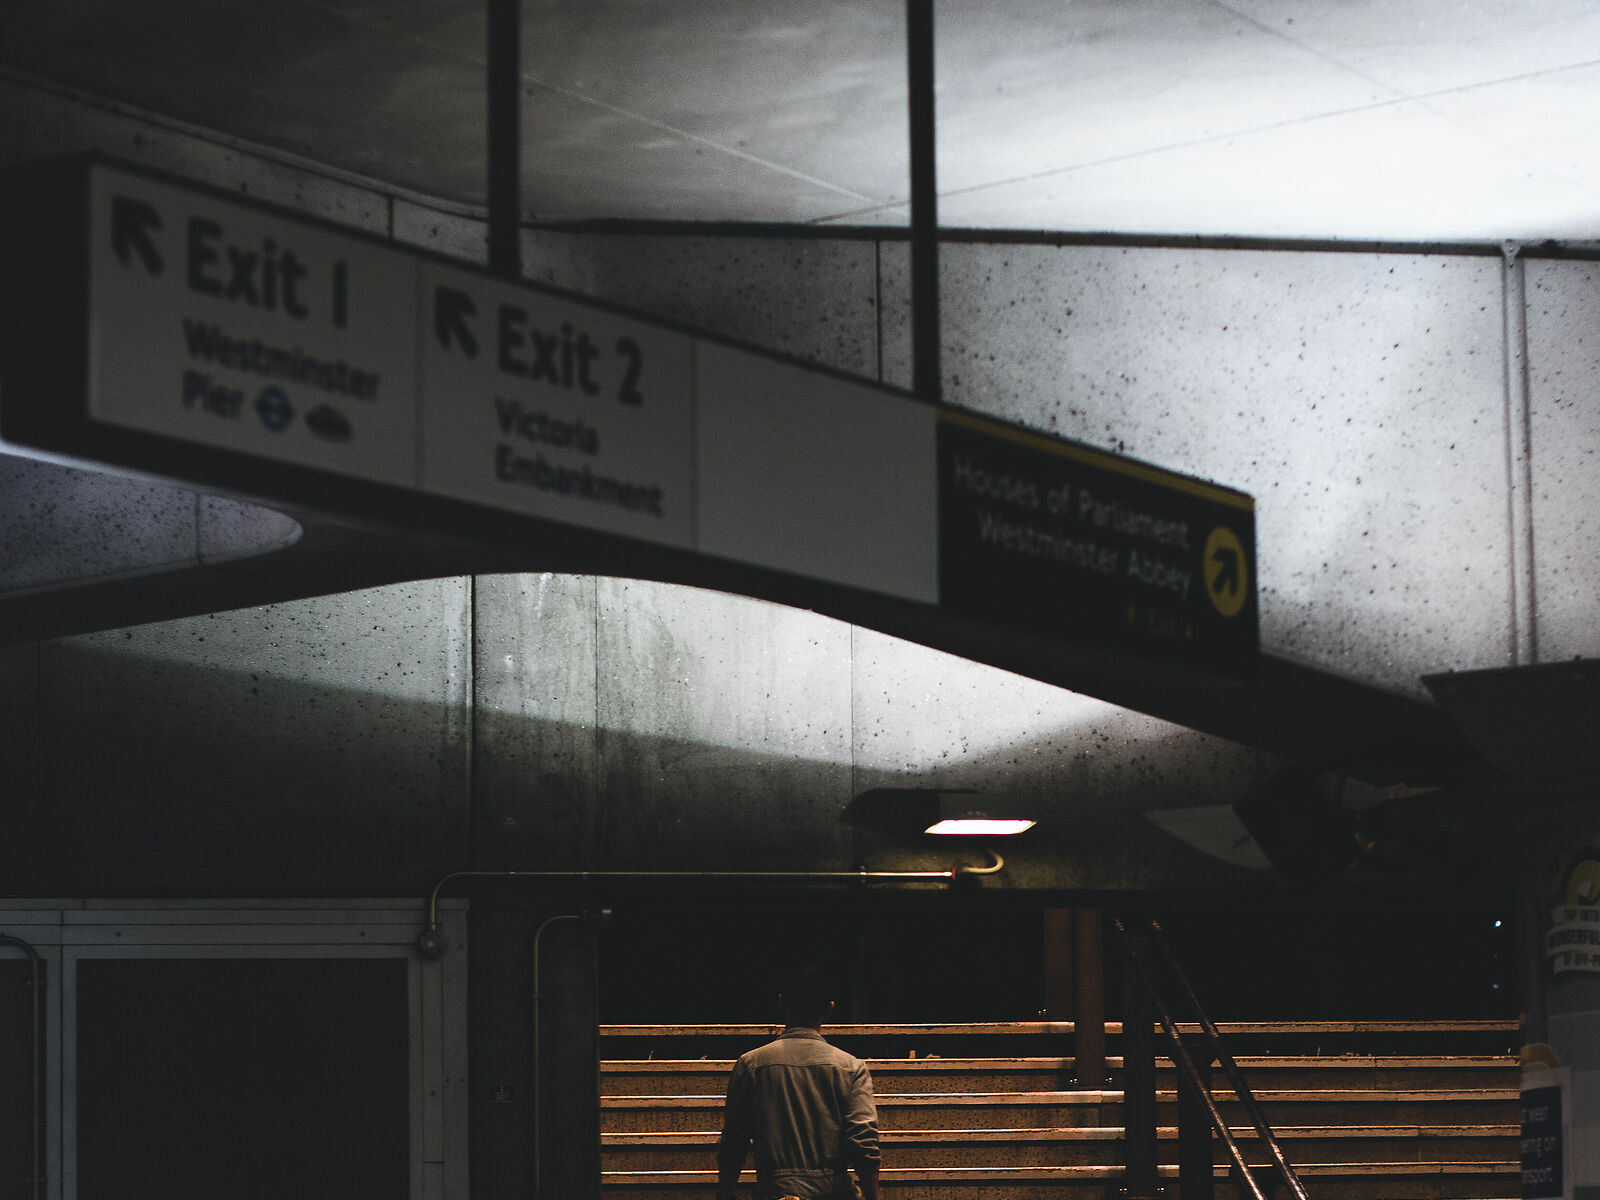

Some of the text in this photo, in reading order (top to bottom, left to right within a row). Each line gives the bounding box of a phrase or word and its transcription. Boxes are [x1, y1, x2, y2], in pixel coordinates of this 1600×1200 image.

[186, 215, 348, 330] Exit 1
[183, 318, 380, 402] Westminster
[183, 371, 243, 421] Pier
[498, 304, 645, 407] Exit 2
[496, 399, 598, 456] Victoria
[495, 444, 662, 517] Embankment
[954, 455, 1189, 550] Houses of Parliament
[978, 508, 1191, 601] Westminster Abbey
